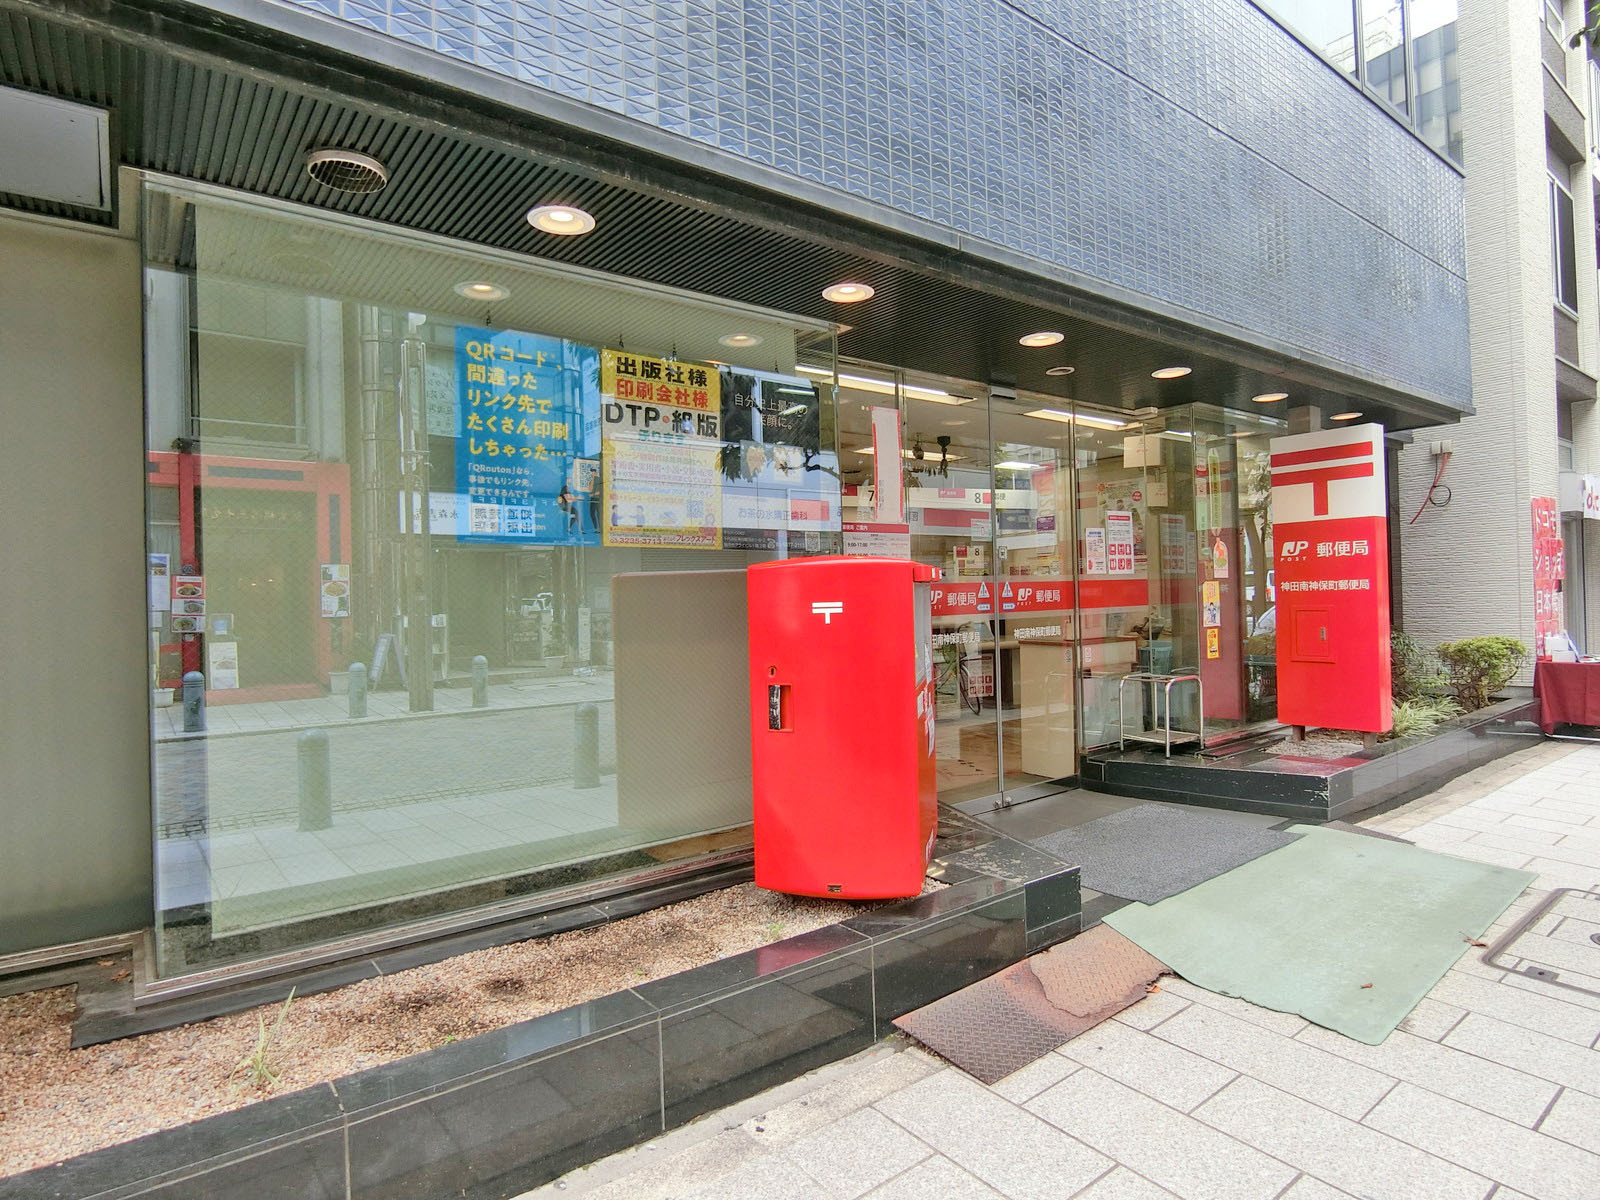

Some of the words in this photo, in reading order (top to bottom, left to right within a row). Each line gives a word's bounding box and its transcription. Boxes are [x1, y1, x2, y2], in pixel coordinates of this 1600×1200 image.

[467, 363, 537, 390] 間違った
[616, 357, 707, 387] 出版社様
[616, 378, 708, 408] 印刷会社様
[468, 389, 552, 414] リンク先で
[467, 413, 568, 440] たくさん印刷
[975, 493, 982, 504] 8
[1316, 540, 1369, 557] 郵便局
[1280, 579, 1370, 592] 神田南神保町郵便局
[947, 592, 977, 606] 郵便局
[1035, 589, 1061, 602] 郵便局
[931, 631, 981, 647] 田南神保町郵便局
[1013, 625, 1062, 640] 神田南神保町郵便局
